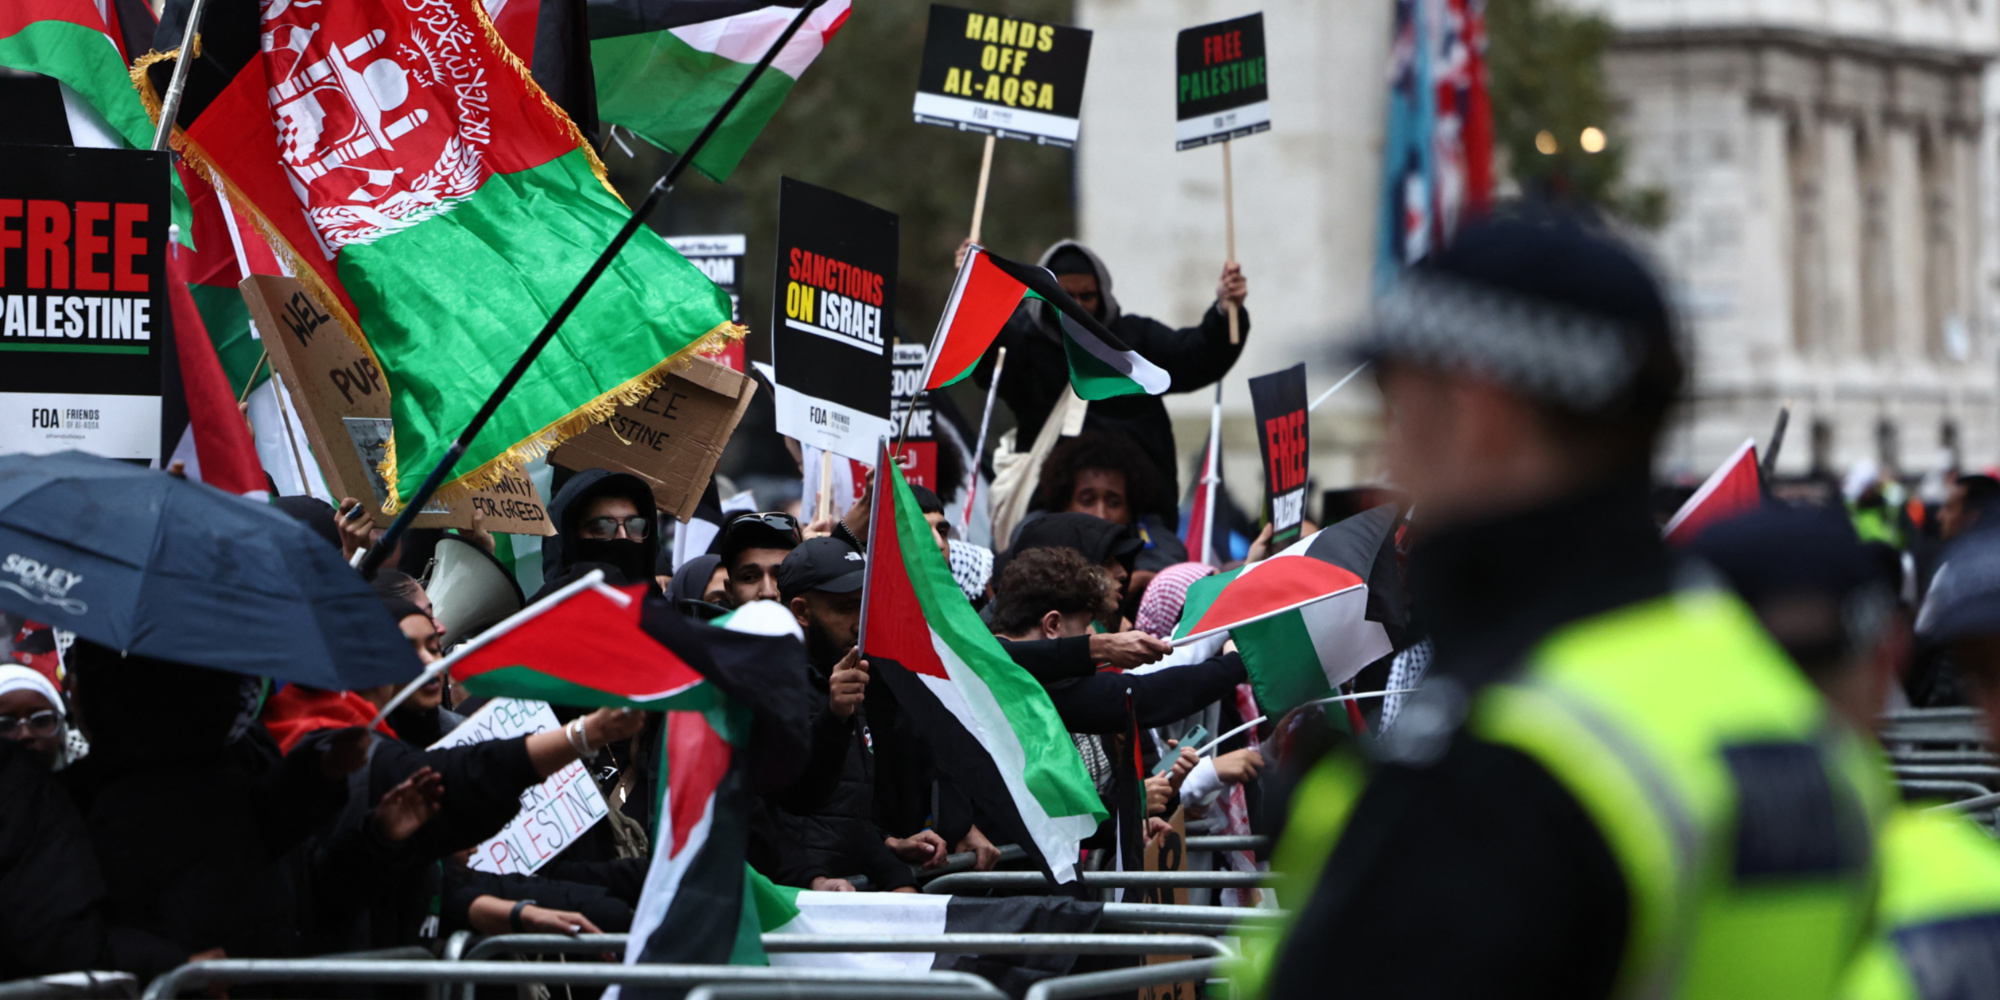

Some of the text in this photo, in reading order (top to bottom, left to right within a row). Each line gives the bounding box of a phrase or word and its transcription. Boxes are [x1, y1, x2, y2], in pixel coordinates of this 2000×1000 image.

[965, 13, 1055, 52] HANDS
[1204, 29, 1242, 66] FREE
[980, 44, 1028, 76] OFF
[943, 67, 1054, 110] AL-AQSA
[1180, 56, 1265, 104] PALESTINE
[0, 198, 149, 292] FREE
[789, 246, 884, 307] SANCTIONS
[786, 281, 815, 323] ON
[820, 289, 885, 346] ISRAEL
[32, 408, 60, 429] FOA
[66, 409, 100, 420] FRIENDS
[636, 384, 688, 420] EE
[810, 405, 827, 426] FOA
[600, 412, 670, 451] ESTINE
[889, 409, 932, 437] STINE
[1265, 408, 1306, 493] FREE
[472, 497, 545, 521] FOR GREED
[1, 553, 84, 592] SIDLEY
[489, 772, 607, 875] PALESTINE
